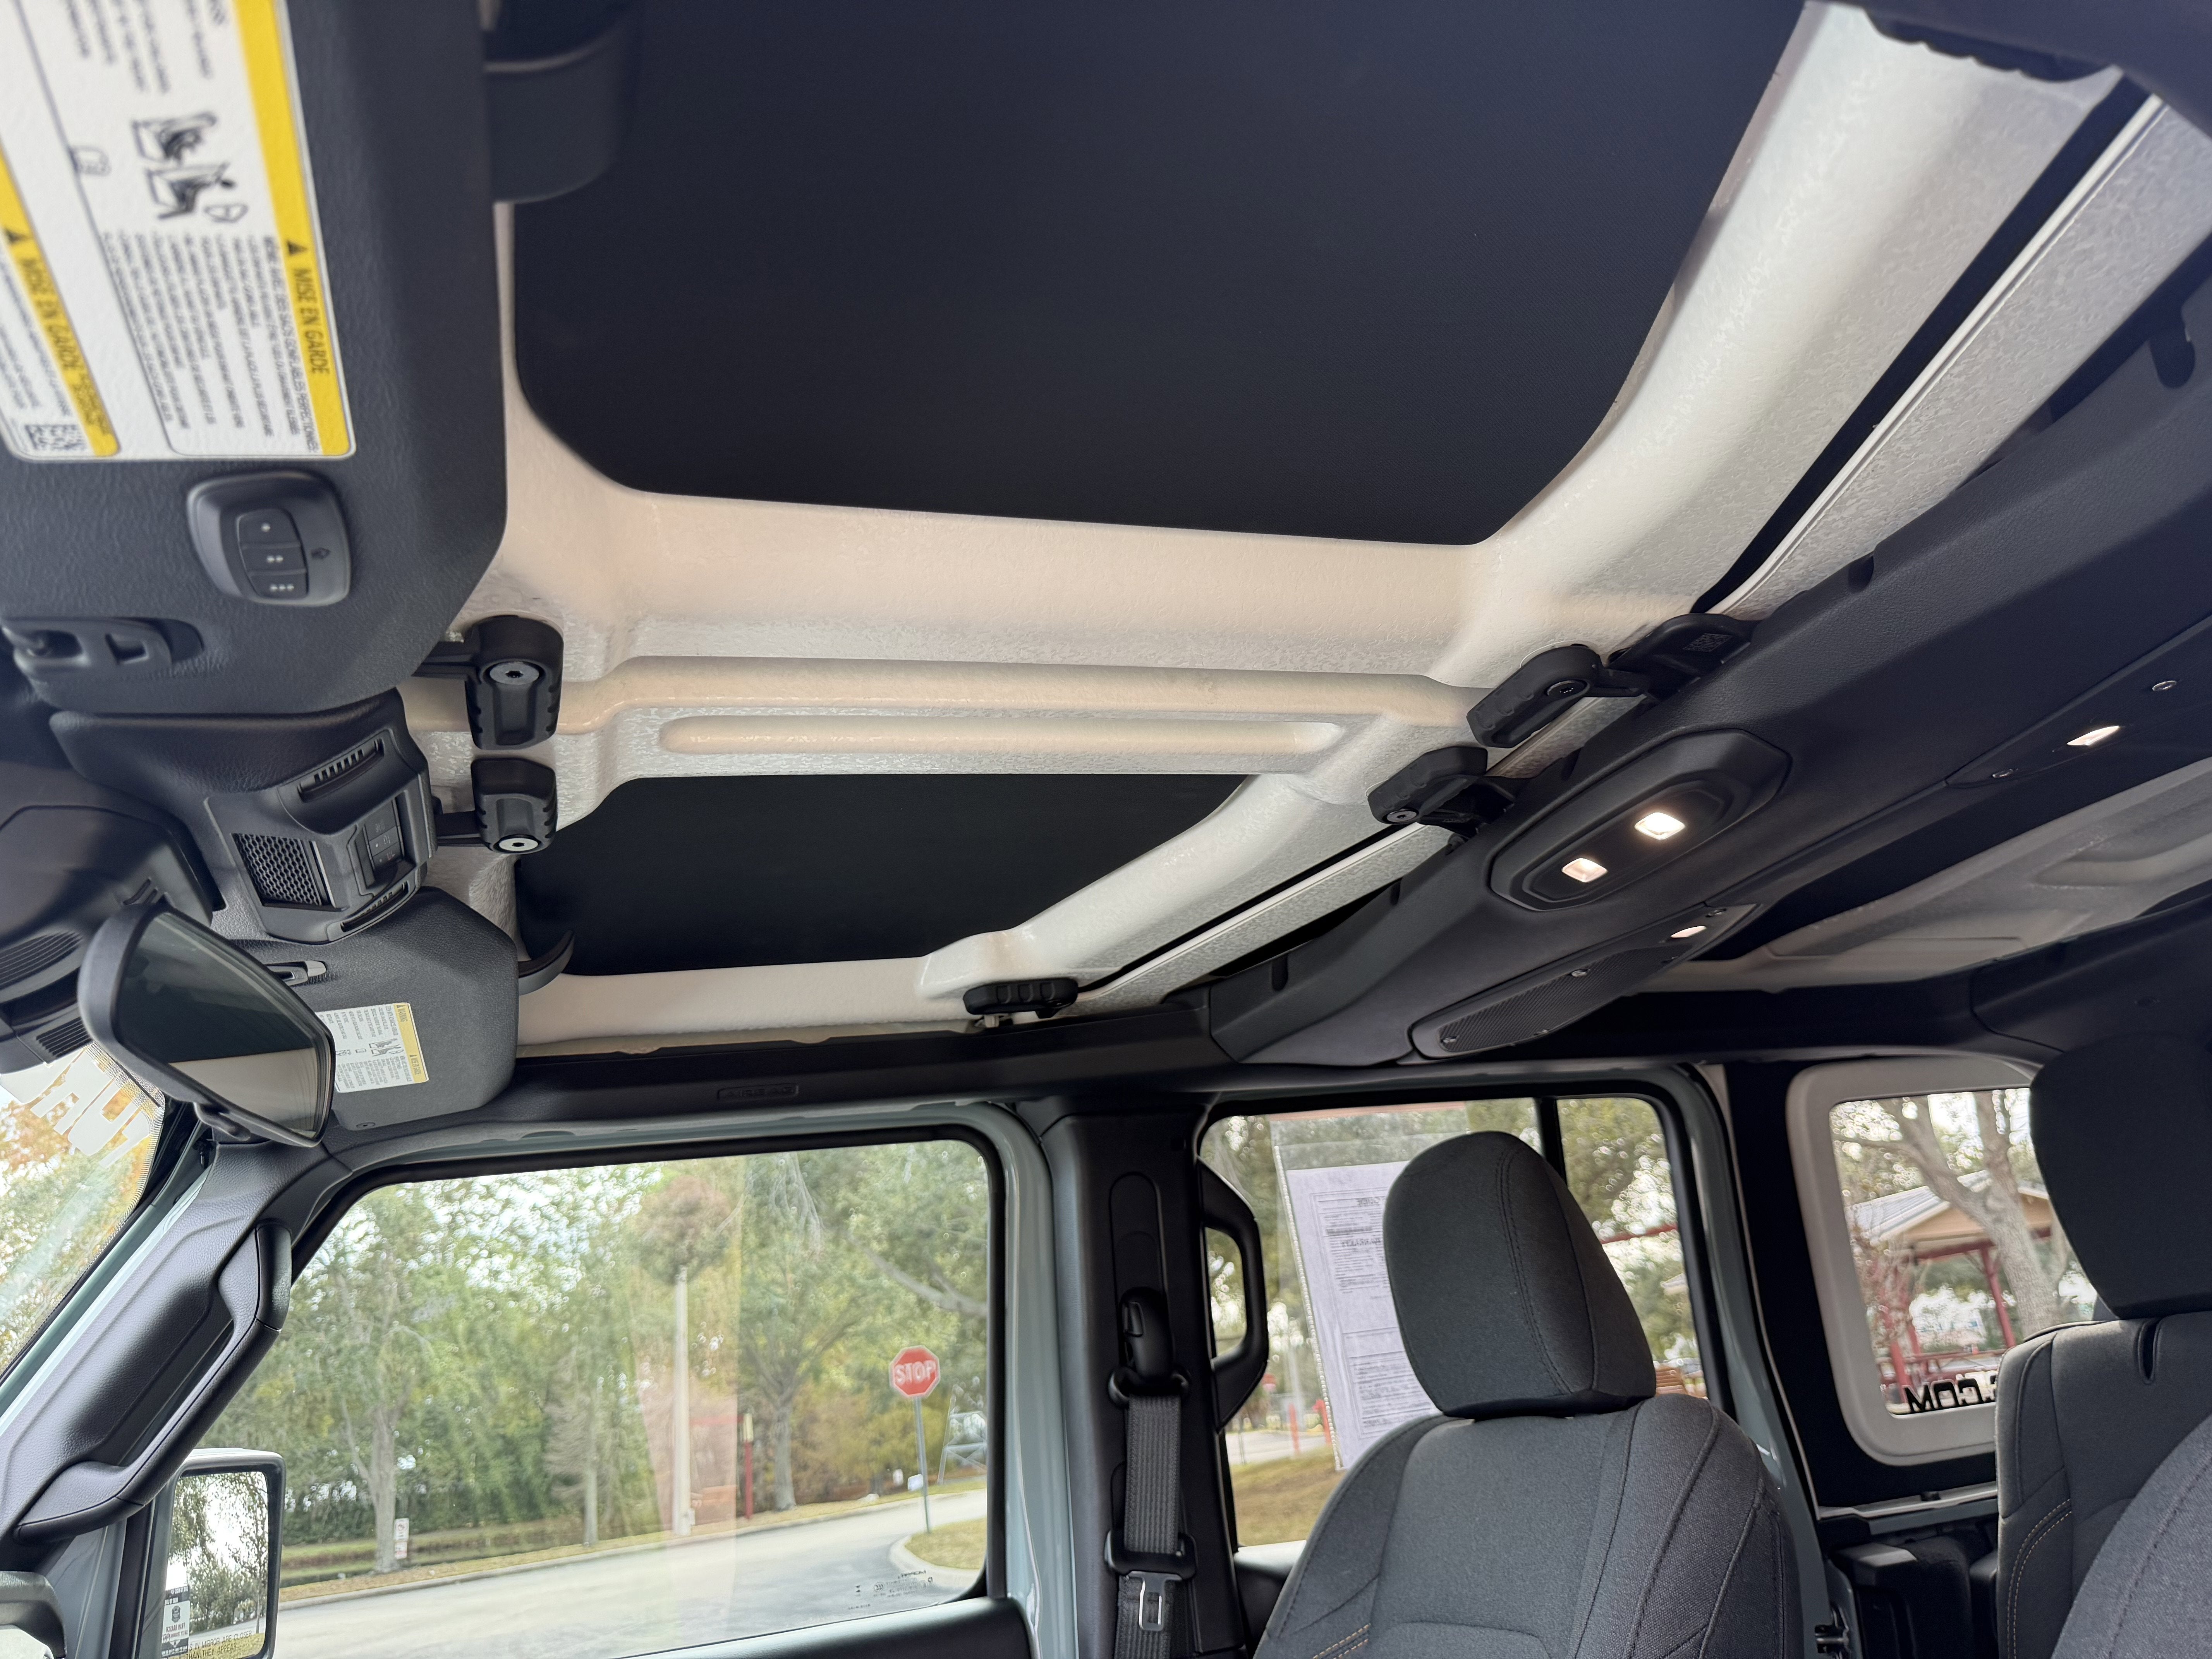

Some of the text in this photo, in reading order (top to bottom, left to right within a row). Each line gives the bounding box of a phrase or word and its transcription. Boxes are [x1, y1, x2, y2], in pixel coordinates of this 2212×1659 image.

[292, 268, 330, 374] MISE EN GARDE
[894, 1360, 936, 1385] STOP
[202, 1637, 220, 1649] MIRROR
[222, 1635, 232, 1643] ARE
[234, 1630, 252, 1640] CLOSER
[186, 1649, 200, 1659] THAN
[202, 1648, 214, 1657] THEY
[217, 1643, 237, 1653] APPEAR
